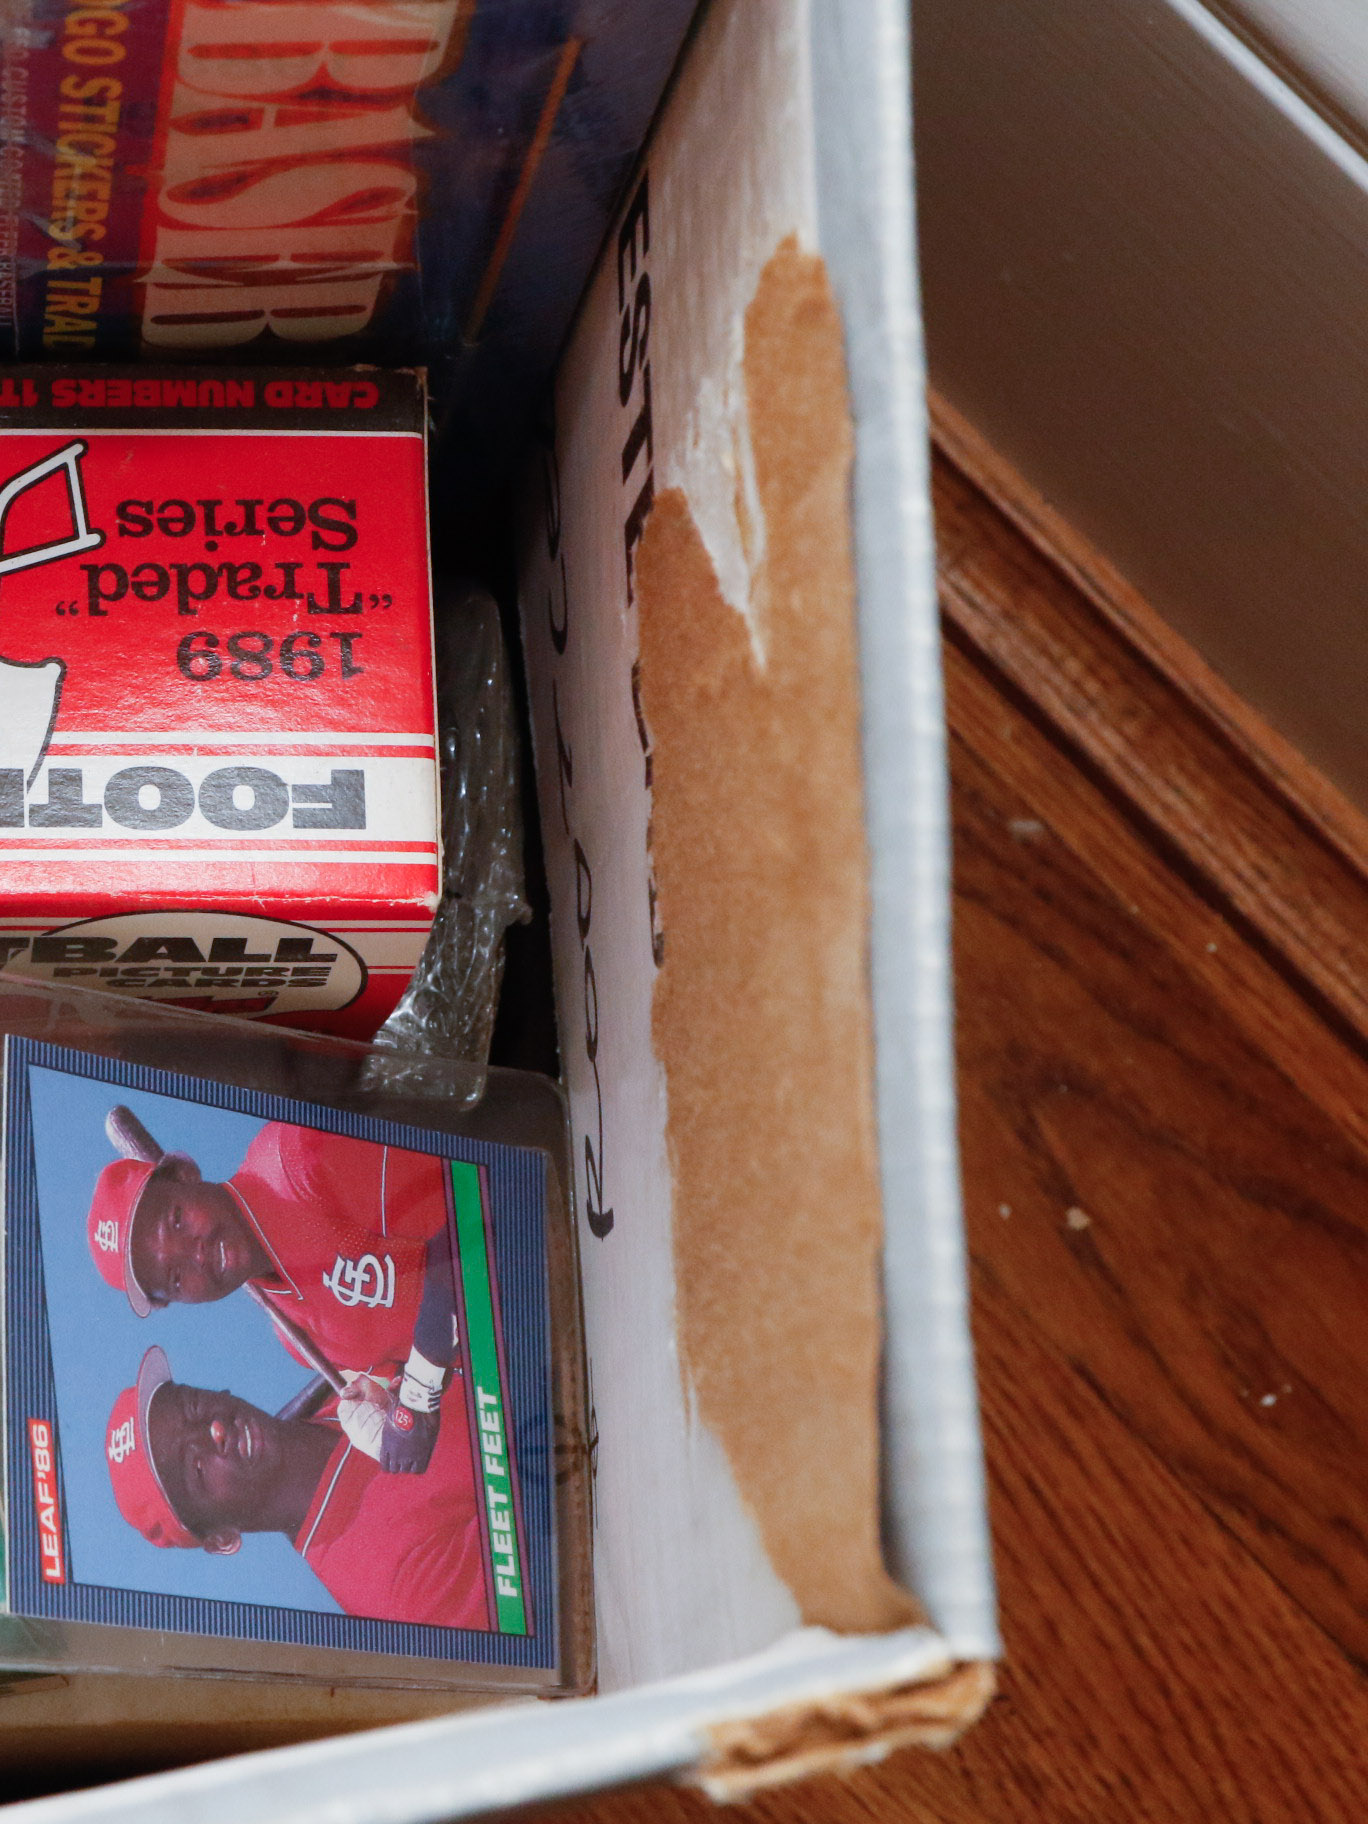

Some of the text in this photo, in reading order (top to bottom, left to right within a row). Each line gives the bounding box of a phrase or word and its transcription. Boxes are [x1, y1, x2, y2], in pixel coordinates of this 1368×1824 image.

[48, 75, 124, 242] STICKERS
[47, 247, 104, 270] &
[51, 379, 255, 410] NUMBERS
[263, 382, 381, 410] CARD
[115, 497, 358, 552] Series
[176, 630, 364, 682] 1989
[52, 966, 332, 978] PICTURE
[106, 977, 329, 988] CARDS
[476, 1387, 518, 1598] FLEET FEET
